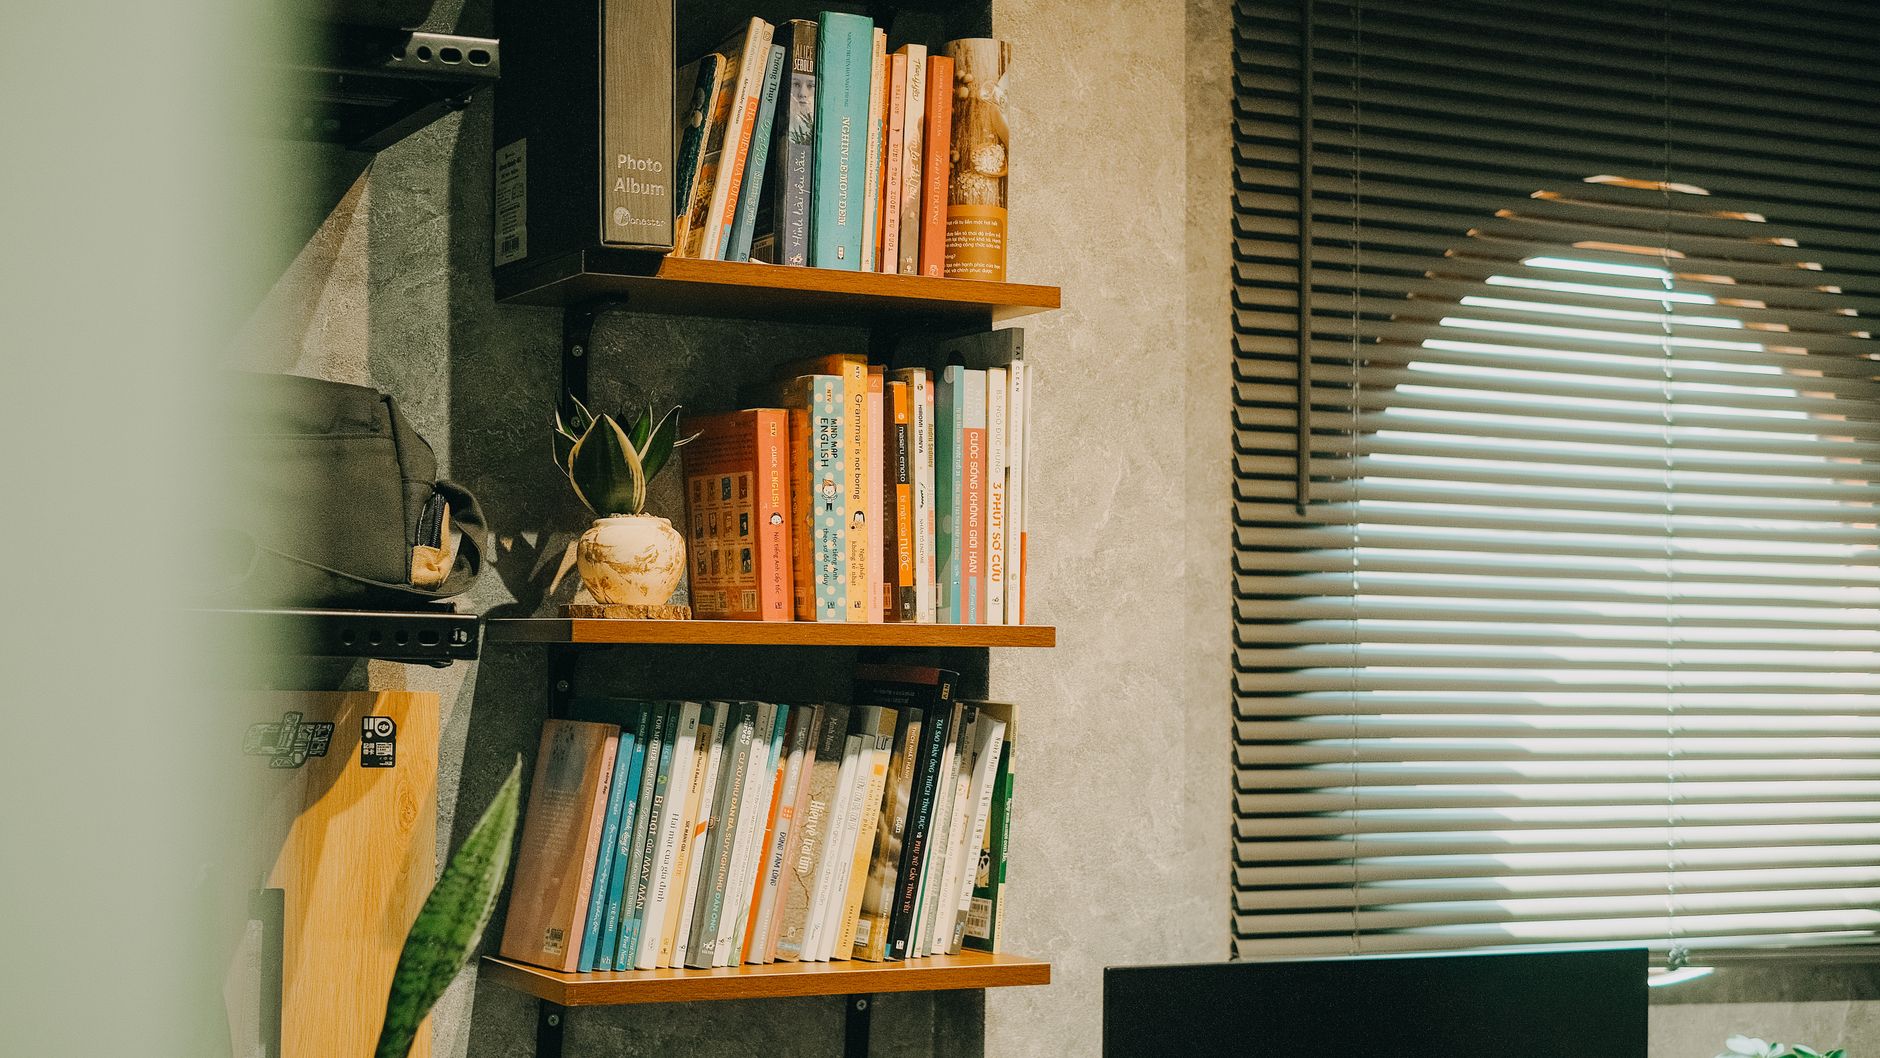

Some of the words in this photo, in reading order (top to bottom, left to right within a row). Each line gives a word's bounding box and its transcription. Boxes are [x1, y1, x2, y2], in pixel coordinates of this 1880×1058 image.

[795, 44, 813, 60] ALICE
[794, 60, 814, 72] SEBOLD
[618, 154, 662, 172] Photo
[614, 178, 664, 195] Album
[821, 418, 829, 467] ENGLISH
[854, 473, 862, 500] boring
[993, 493, 1003, 529] PHÚT
[993, 532, 1001, 551] SƠ
[992, 554, 1004, 582] CỨU
[941, 683, 950, 700] NTV
[655, 715, 663, 729] FOR
[740, 714, 751, 745] Harvey
[828, 717, 838, 734] Minh
[744, 721, 754, 746] Steve
[933, 730, 942, 743] SAO
[650, 730, 660, 762] MOTHER
[928, 758, 937, 774] ÔNG
[646, 779, 653, 787] of
[644, 786, 652, 801] love
[654, 795, 664, 810] Bí
[669, 813, 679, 830] Hai
[723, 832, 732, 849] SUY
[640, 856, 652, 882] MAY
[797, 856, 812, 874] tim
